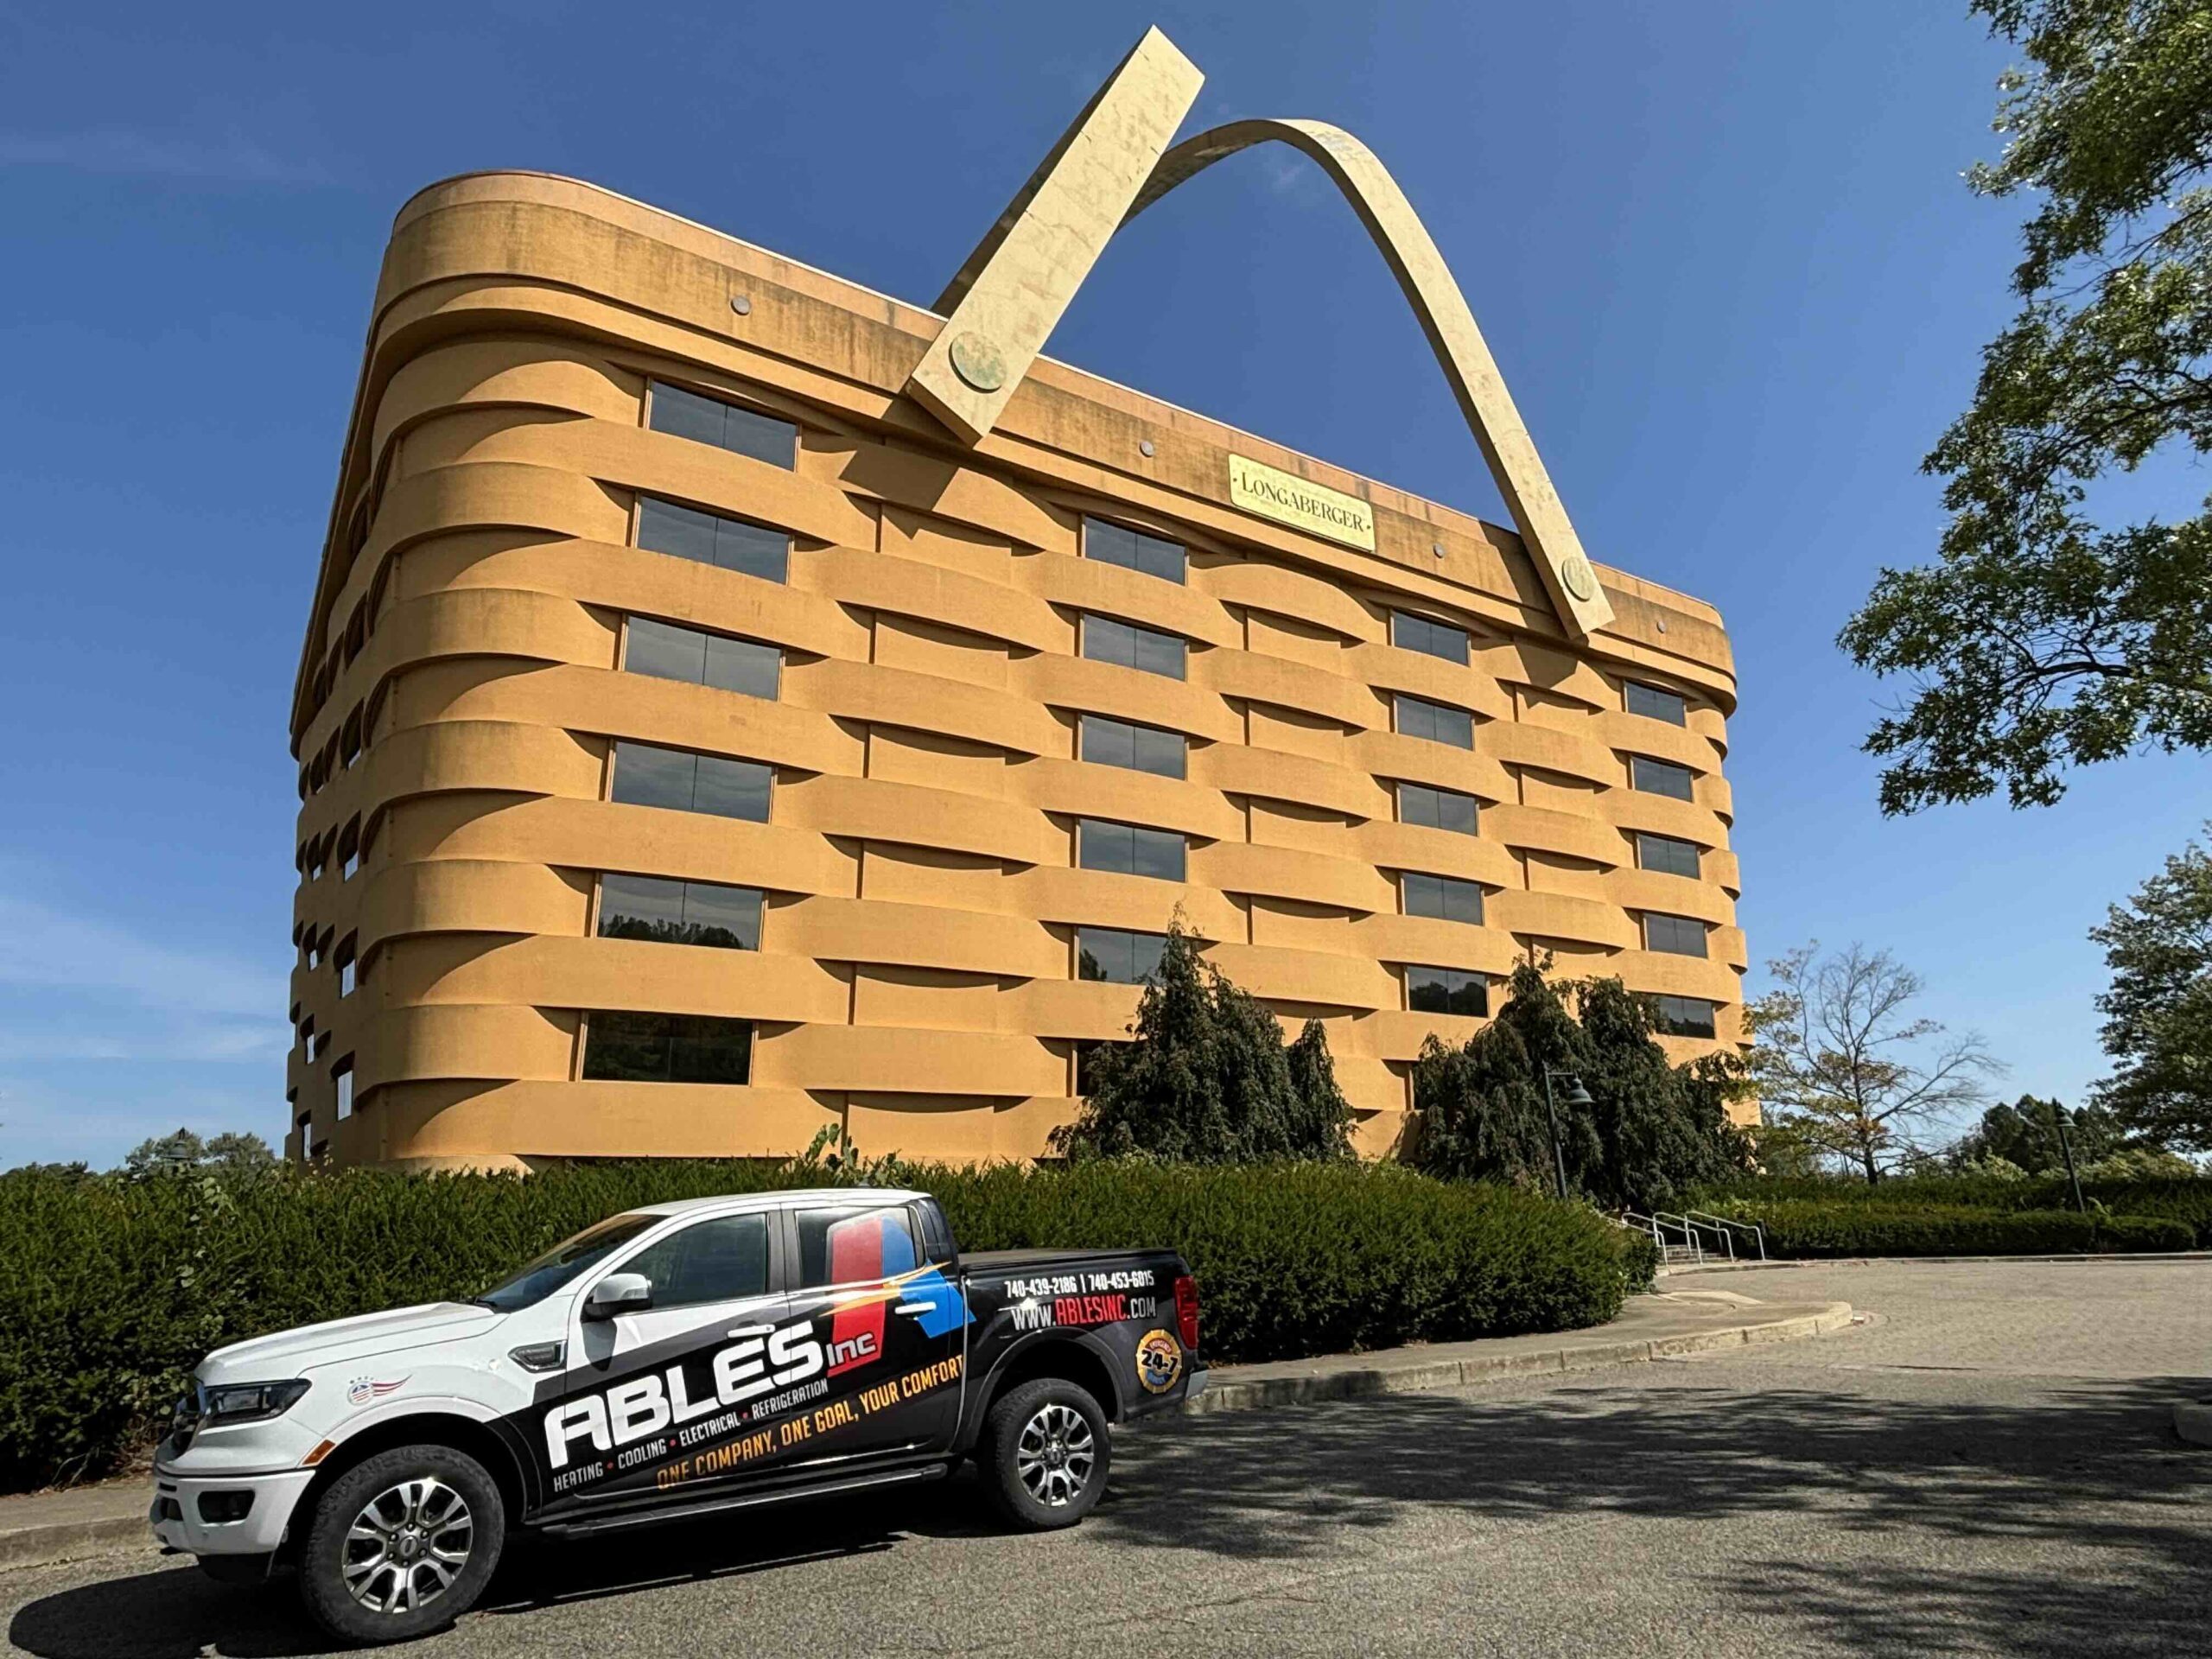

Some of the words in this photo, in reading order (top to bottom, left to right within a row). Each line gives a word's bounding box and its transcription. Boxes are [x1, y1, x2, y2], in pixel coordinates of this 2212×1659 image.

[1242, 472, 1363, 532] LONGABERGER
[1004, 1276, 1077, 1298] 740-439-2186
[1011, 1294, 1156, 1331] WWW.ABLESINC.COM
[544, 1320, 823, 1468] ABLES
[554, 1462, 603, 1492] HEATING
[618, 1439, 666, 1469] COOLING
[679, 1412, 741, 1447] ELECTRICAL
[752, 1378, 829, 1420] REFRIGERATION
[657, 1461, 690, 1490] ONE
[696, 1430, 778, 1476] COMPANY,
[781, 1416, 812, 1446] ONE
[815, 1400, 859, 1433] GOAL,
[859, 1383, 899, 1414] YOUR
[903, 1354, 964, 1398] COMFORT
